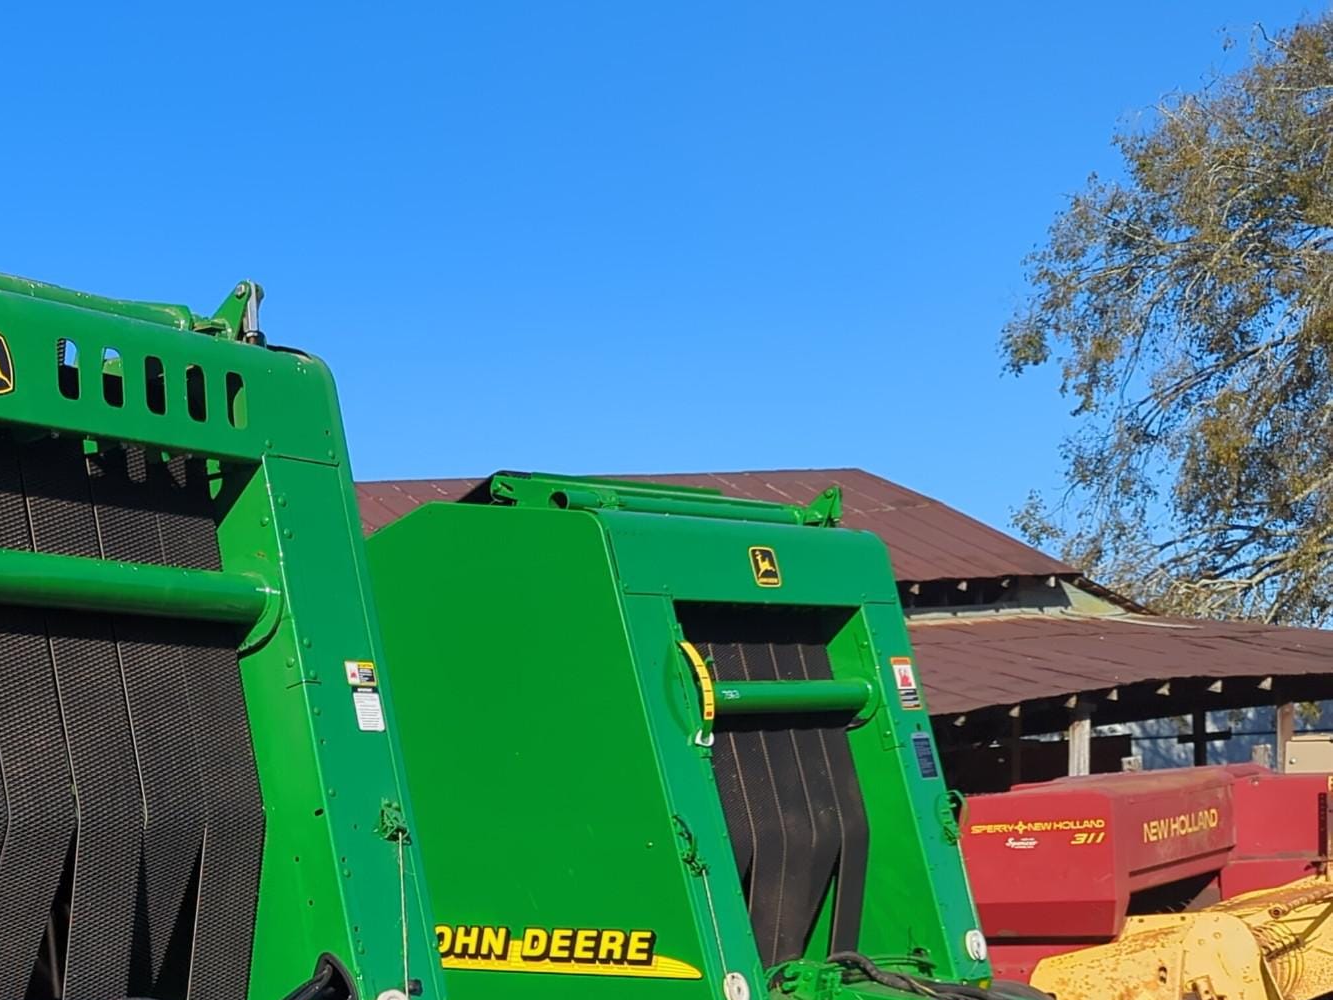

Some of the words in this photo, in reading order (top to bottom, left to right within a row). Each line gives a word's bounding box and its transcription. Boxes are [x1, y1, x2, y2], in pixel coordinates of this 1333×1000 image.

[970, 823, 1014, 834] SPERRY
[1027, 822, 1052, 832] NEW
[1053, 819, 1105, 831] HOLLAND
[1143, 818, 1169, 843] NEW
[1170, 808, 1218, 836] HOLLAND
[1070, 832, 1105, 845] 311
[434, 925, 510, 959] OHN
[522, 927, 655, 965] DEERE
